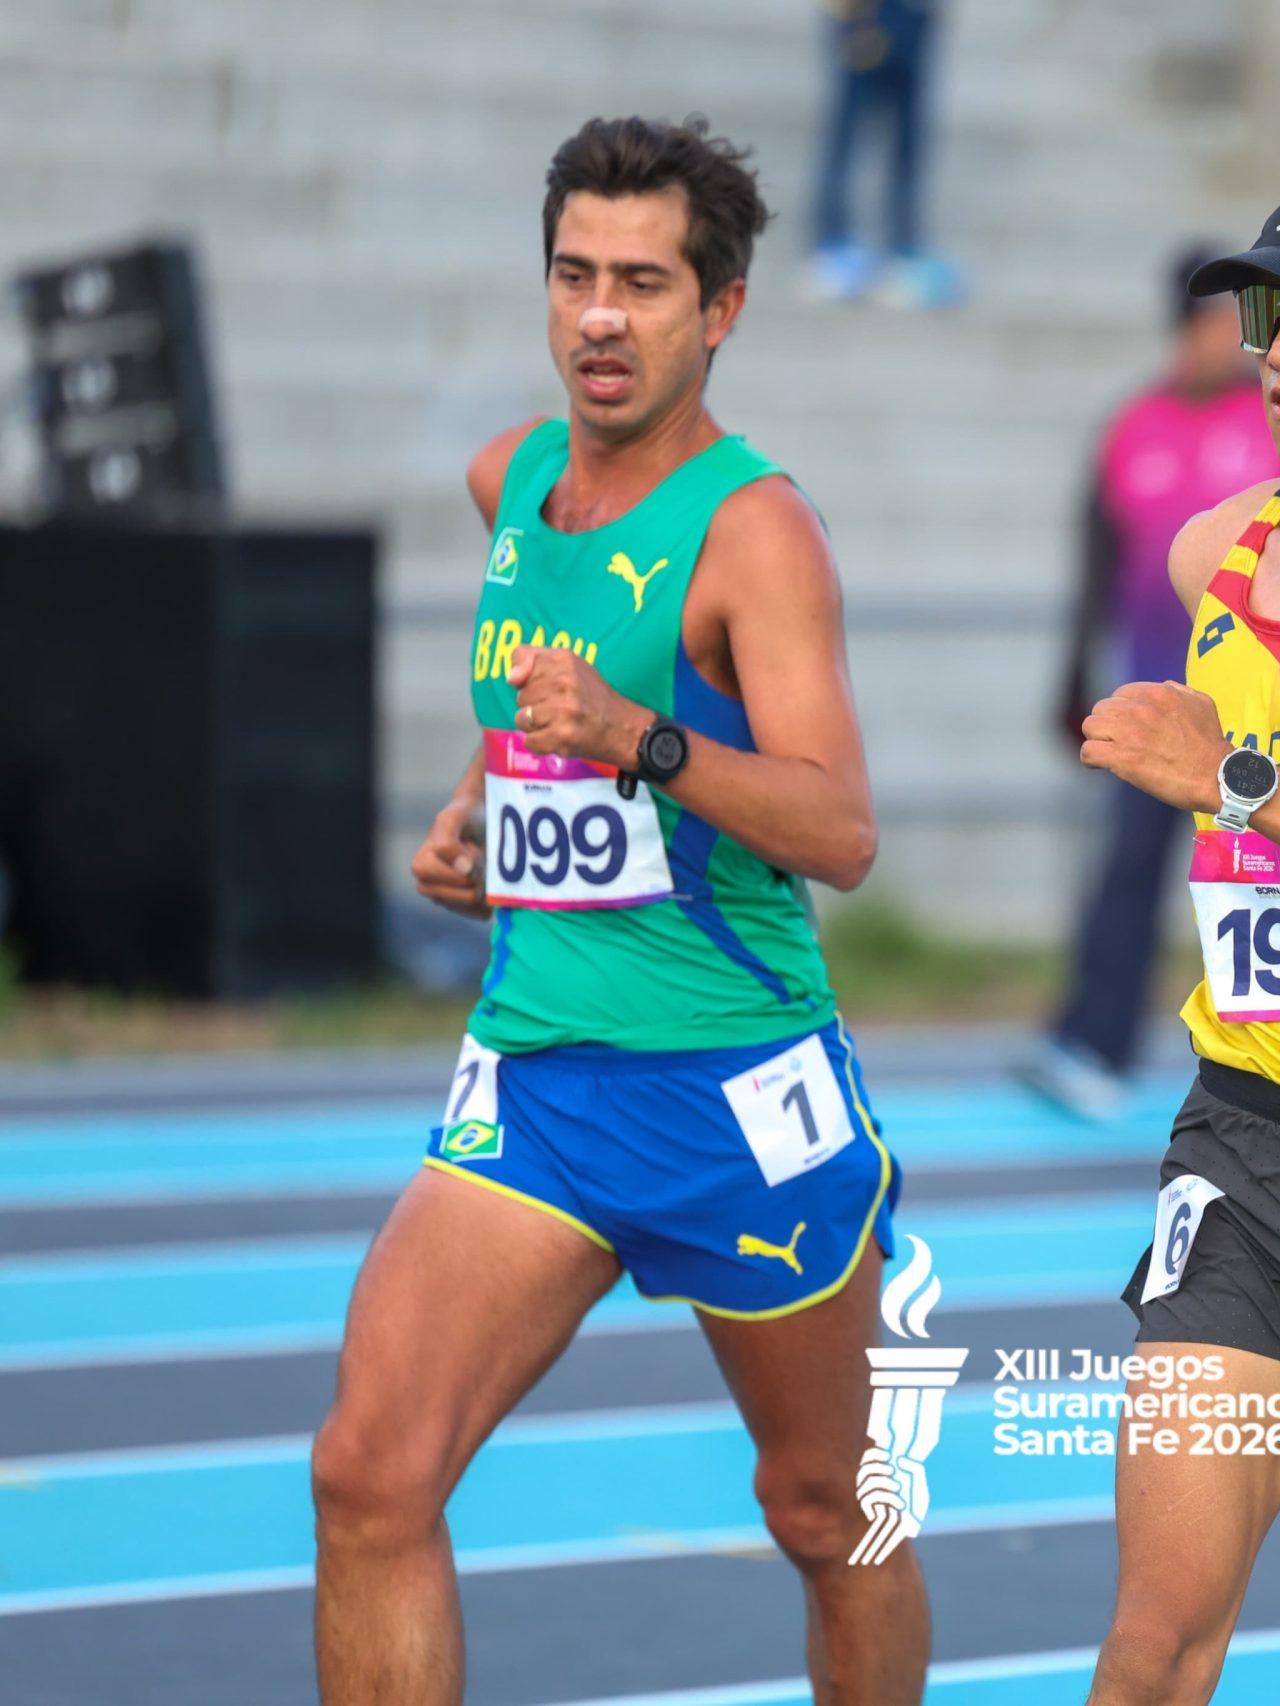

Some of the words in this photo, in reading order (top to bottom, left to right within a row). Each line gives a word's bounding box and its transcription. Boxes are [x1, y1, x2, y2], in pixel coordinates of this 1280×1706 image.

[498, 804, 628, 886] 099
[781, 1079, 820, 1146] 1
[1165, 1202, 1191, 1276] 6
